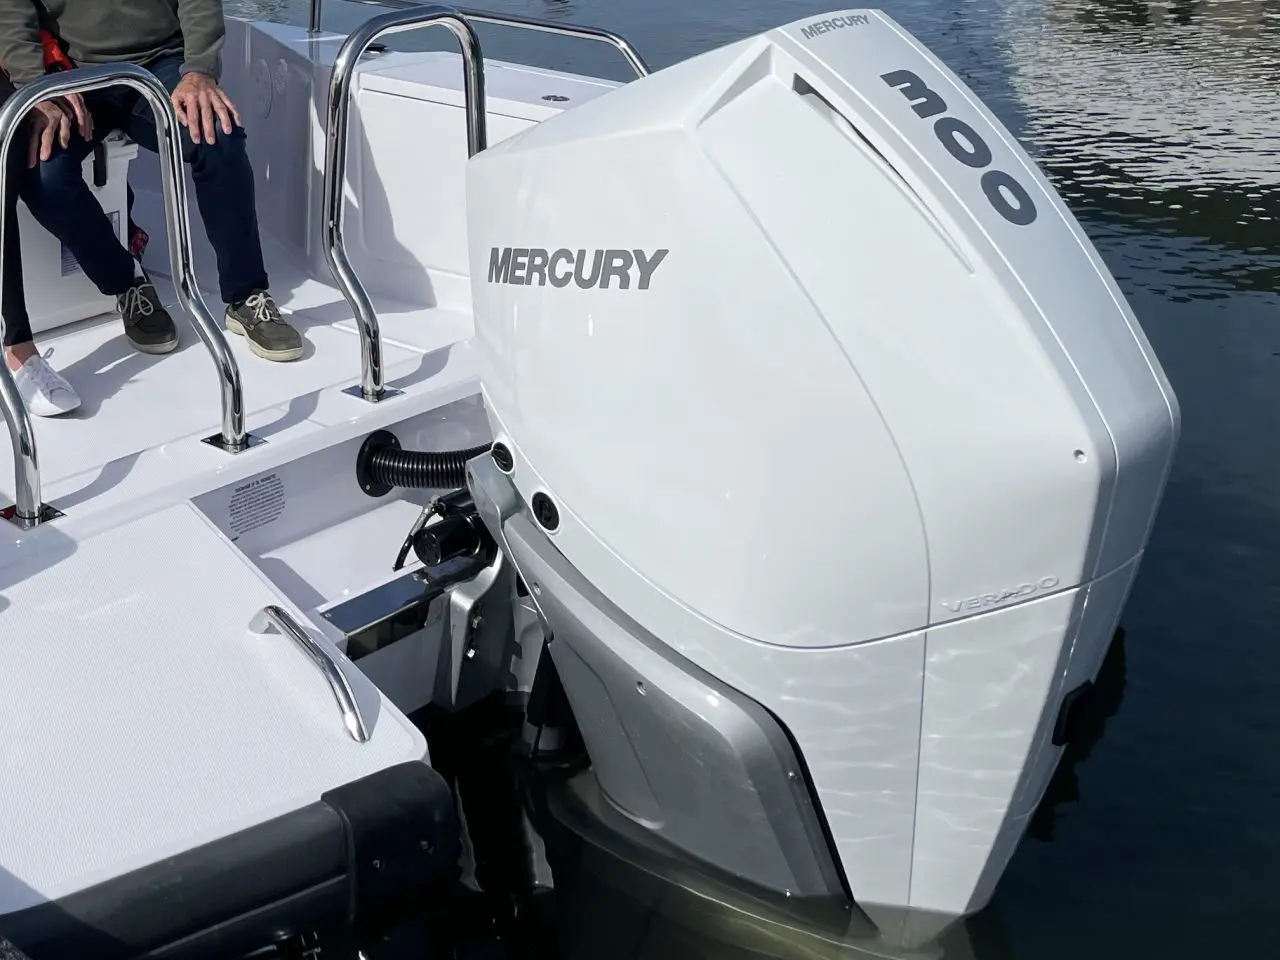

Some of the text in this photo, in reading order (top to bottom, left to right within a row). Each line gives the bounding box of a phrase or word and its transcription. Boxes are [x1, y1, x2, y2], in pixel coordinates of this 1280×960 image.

[800, 14, 871, 40] MERCURY
[879, 69, 1038, 226] 300
[487, 247, 669, 290] MERCURY
[941, 575, 1060, 613] VERADO
